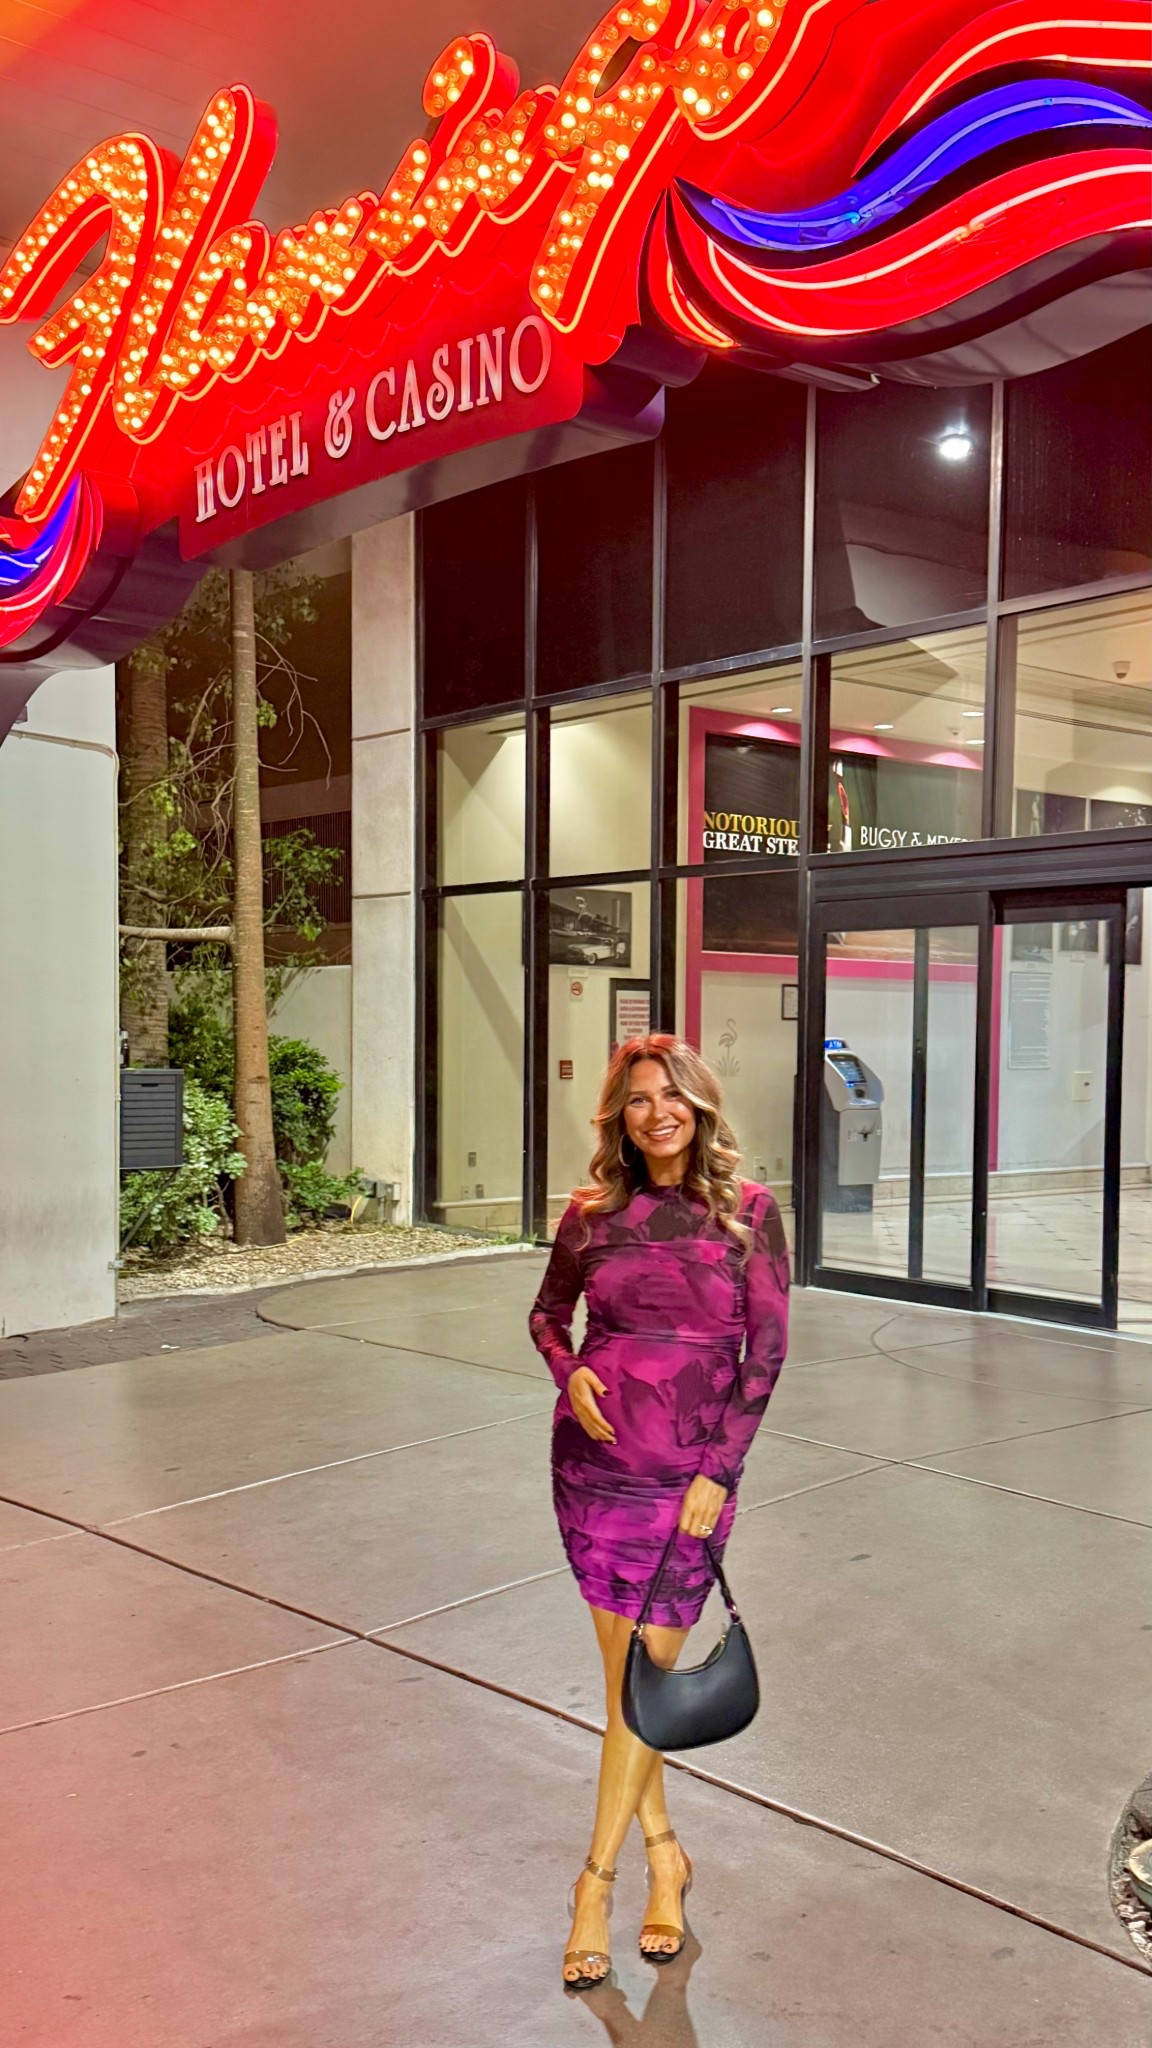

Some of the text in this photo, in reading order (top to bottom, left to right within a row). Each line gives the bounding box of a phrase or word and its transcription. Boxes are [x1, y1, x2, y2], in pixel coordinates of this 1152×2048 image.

[195, 315, 551, 523] HOTEL & CASINO
[703, 831, 762, 852] GREAT
[860, 825, 908, 848] BUGSY
[828, 1040, 843, 1048] ATM
